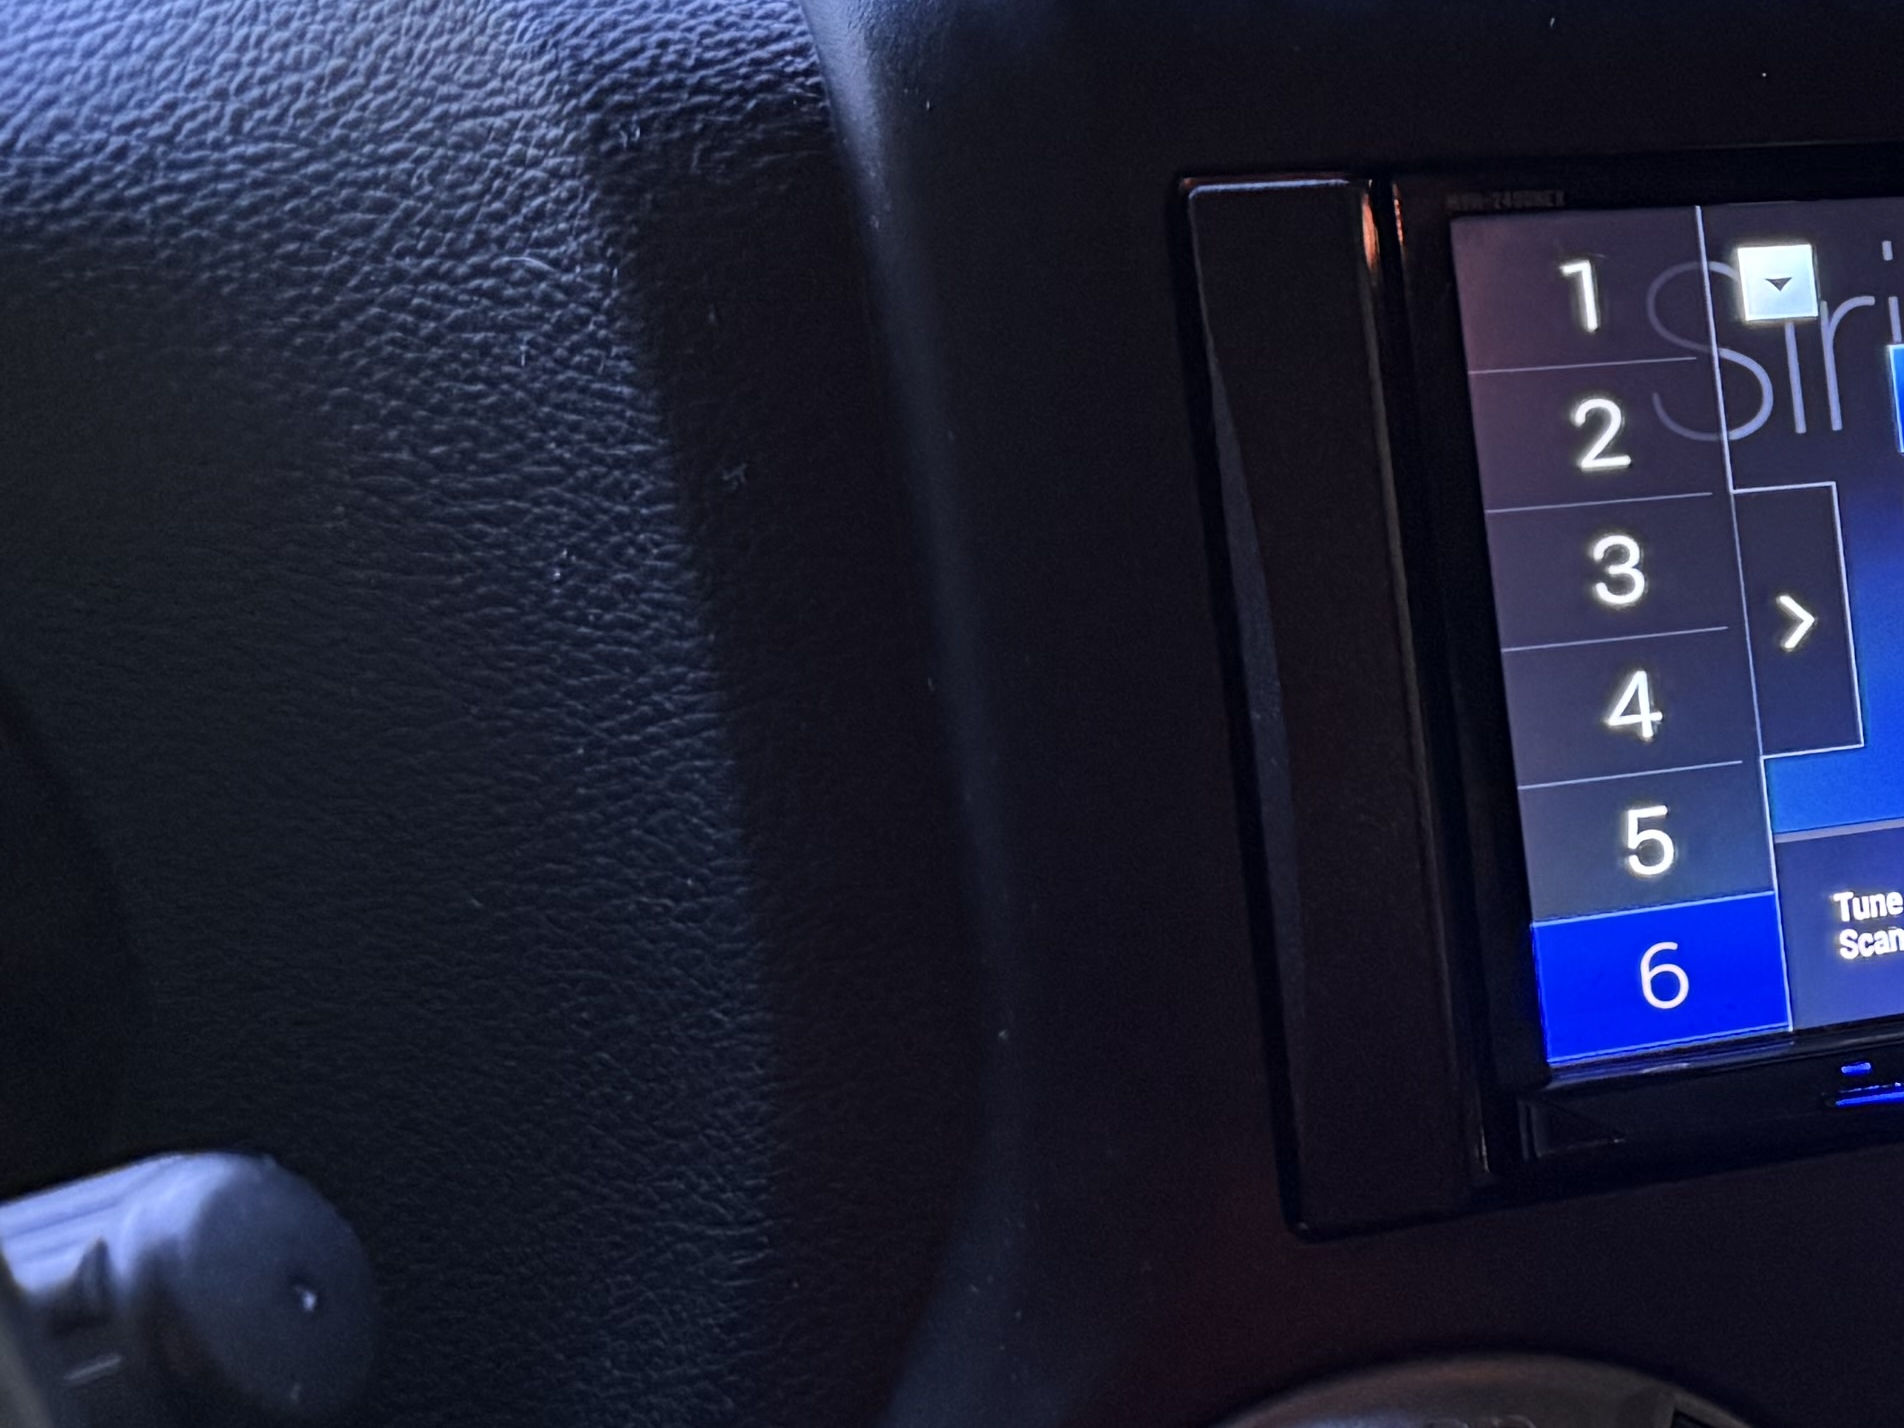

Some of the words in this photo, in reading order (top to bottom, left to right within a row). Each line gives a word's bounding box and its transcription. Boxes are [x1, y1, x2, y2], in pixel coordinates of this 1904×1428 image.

[1560, 260, 1598, 332] 1
[1571, 397, 1632, 471] 2
[1592, 534, 1647, 607] 3
[1604, 670, 1663, 741] 4
[1626, 805, 1675, 878] 5
[1832, 891, 1904, 922] Tune
[1640, 941, 1690, 1010] 6
